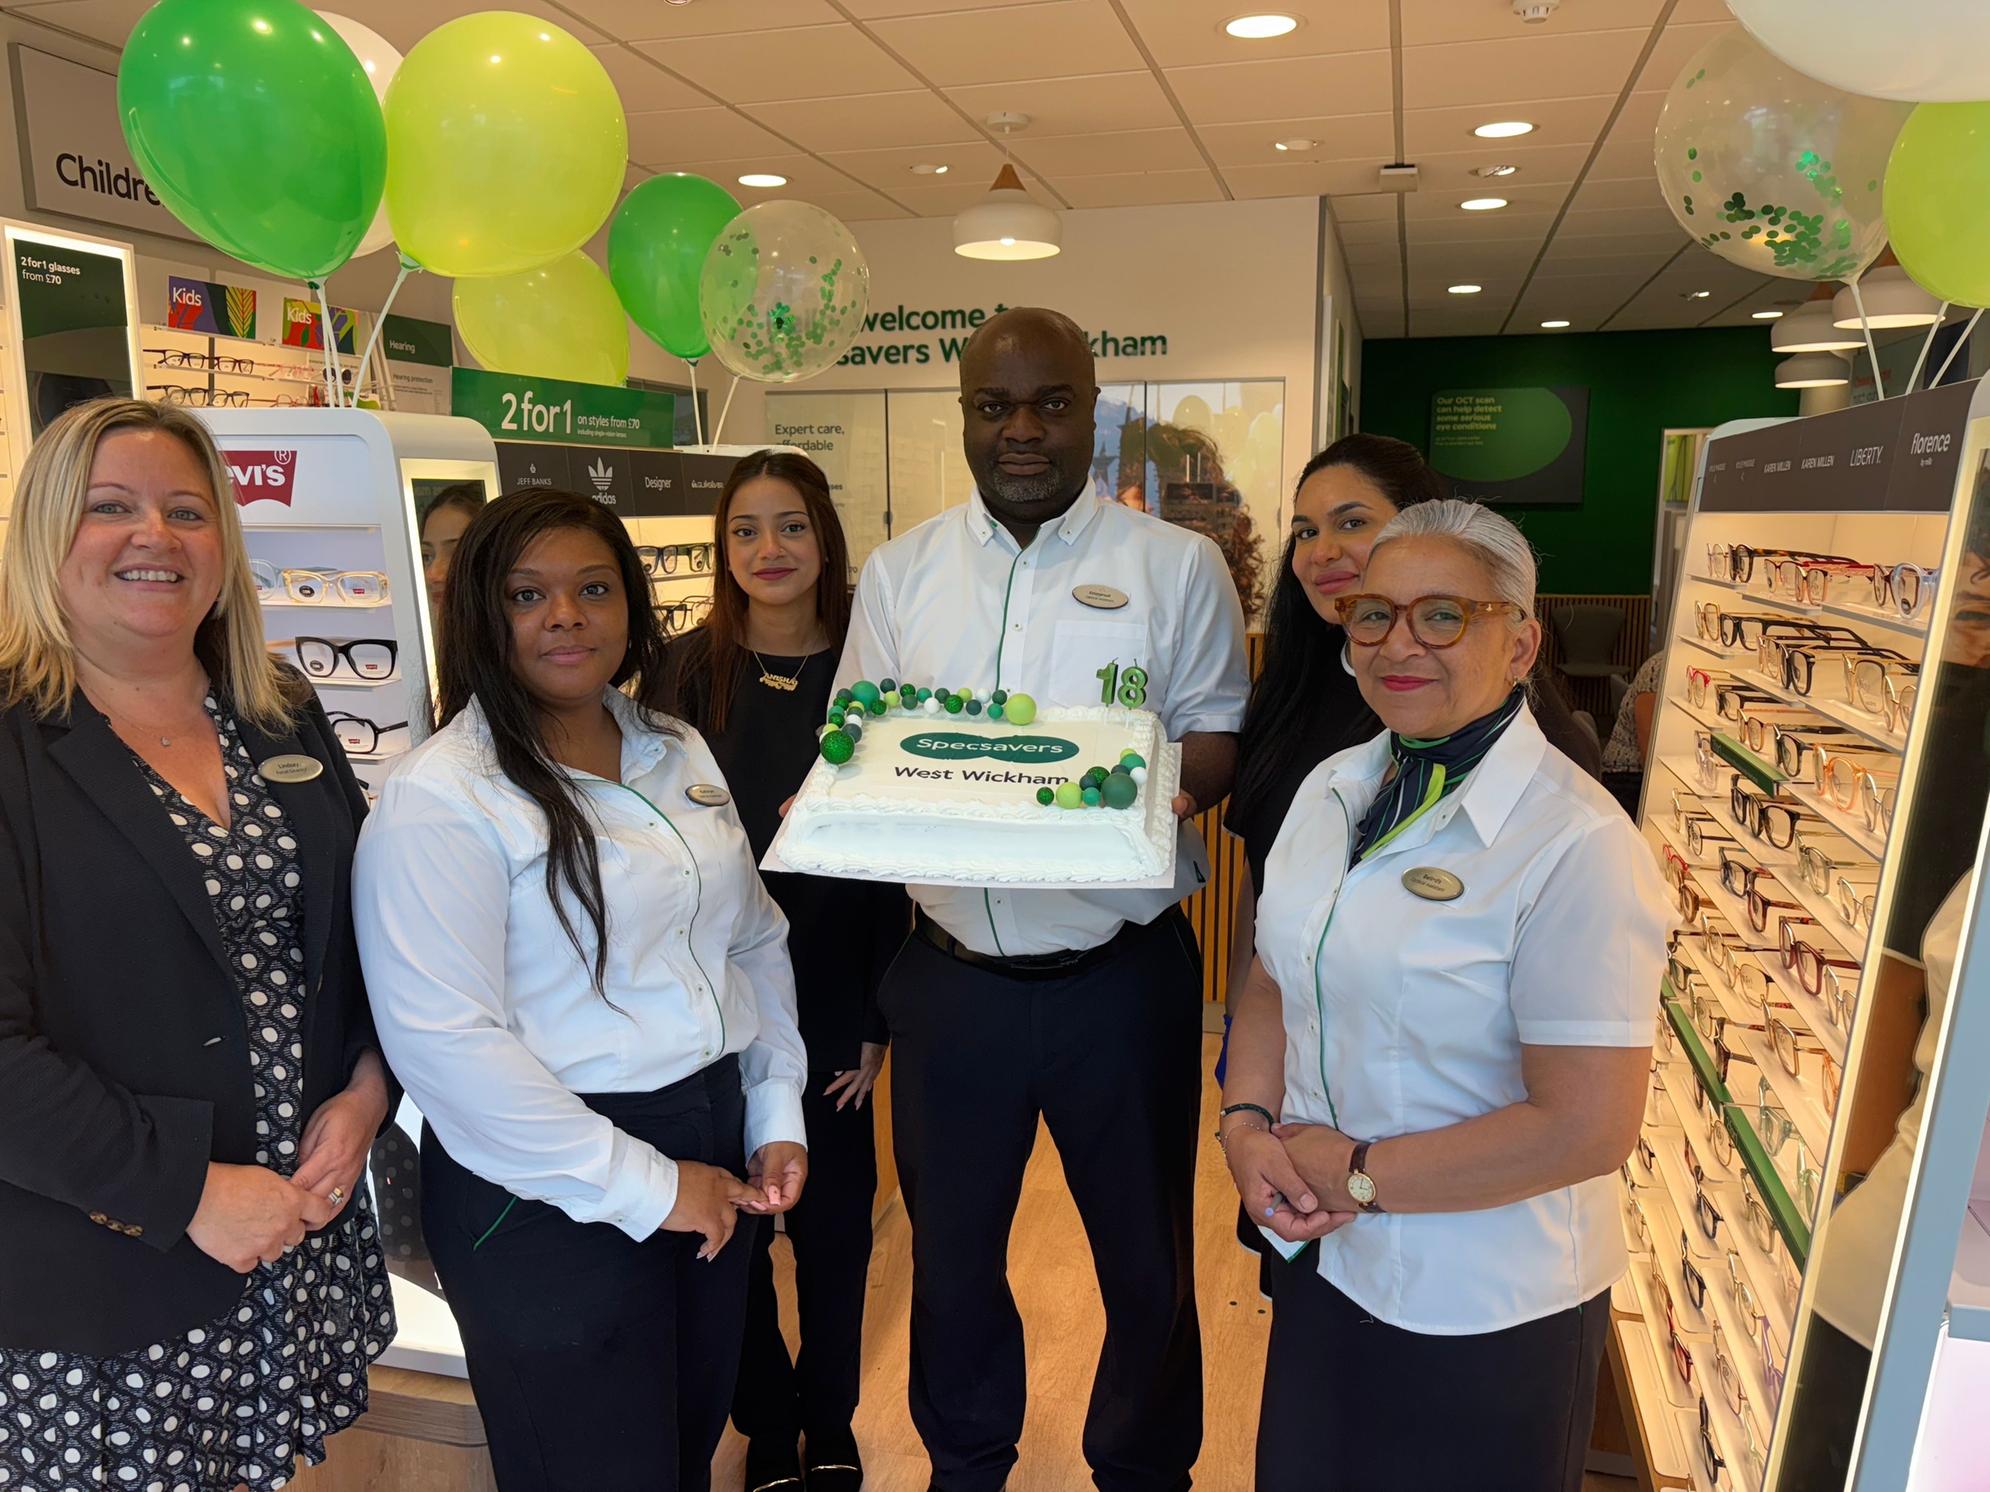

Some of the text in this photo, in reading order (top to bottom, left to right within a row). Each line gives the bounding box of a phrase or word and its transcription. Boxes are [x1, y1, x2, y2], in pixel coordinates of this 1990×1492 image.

[56, 152, 164, 207] Childre
[48, 262, 81, 275] glasses
[22, 269, 62, 285] from £70
[172, 287, 202, 307] Kids
[287, 306, 312, 325] Kids
[389, 339, 416, 355] Hearing
[1437, 396, 1495, 405] Our OCT scan
[1453, 405, 1473, 414] help
[1473, 405, 1503, 413] detect
[577, 415, 641, 430] on styles from £70
[1460, 414, 1492, 422] serious
[775, 424, 845, 437] Expert care,
[1435, 422, 1497, 432] eye conditions
[1910, 432, 1951, 455] florence
[1763, 462, 1777, 473] KAREN
[1777, 460, 1792, 472] MILLEN
[1800, 455, 1835, 470] KAREN MILLEN
[516, 477, 552, 487] JEFF BANKS
[645, 476, 672, 491] Designer
[916, 738, 1064, 754] Specsavers
[894, 766, 1069, 786] West Wickham
